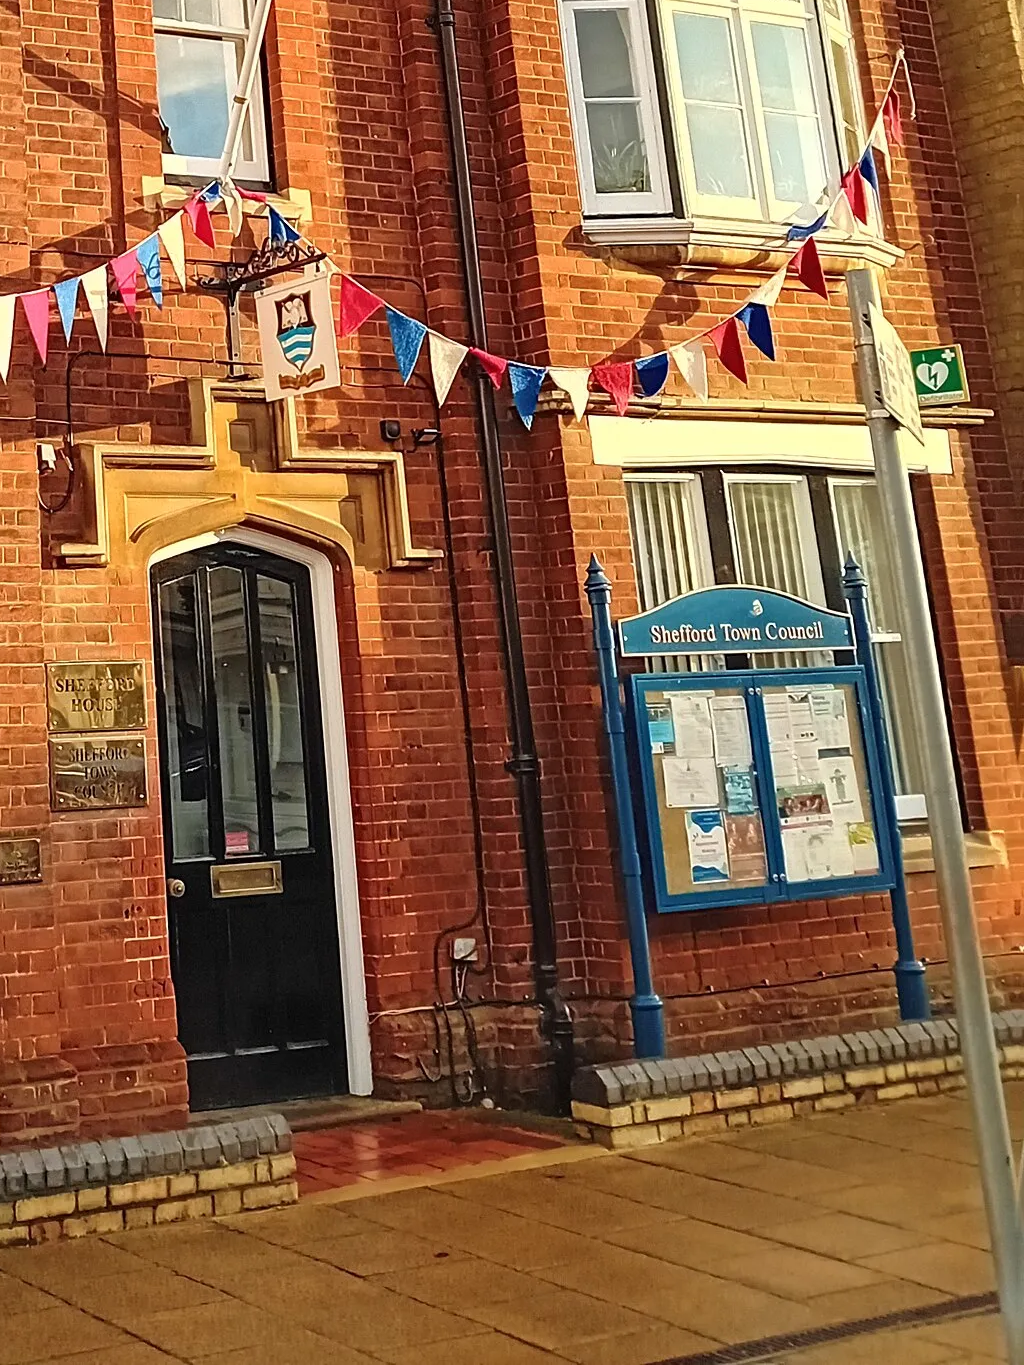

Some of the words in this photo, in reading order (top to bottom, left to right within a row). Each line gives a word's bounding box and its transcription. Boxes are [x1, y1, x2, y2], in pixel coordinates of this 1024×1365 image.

[650, 623, 717, 643] Shefford
[720, 623, 761, 642] Town
[765, 621, 824, 640] Council
[55, 677, 136, 693] SHEFFORD
[71, 697, 123, 713] HOUSE
